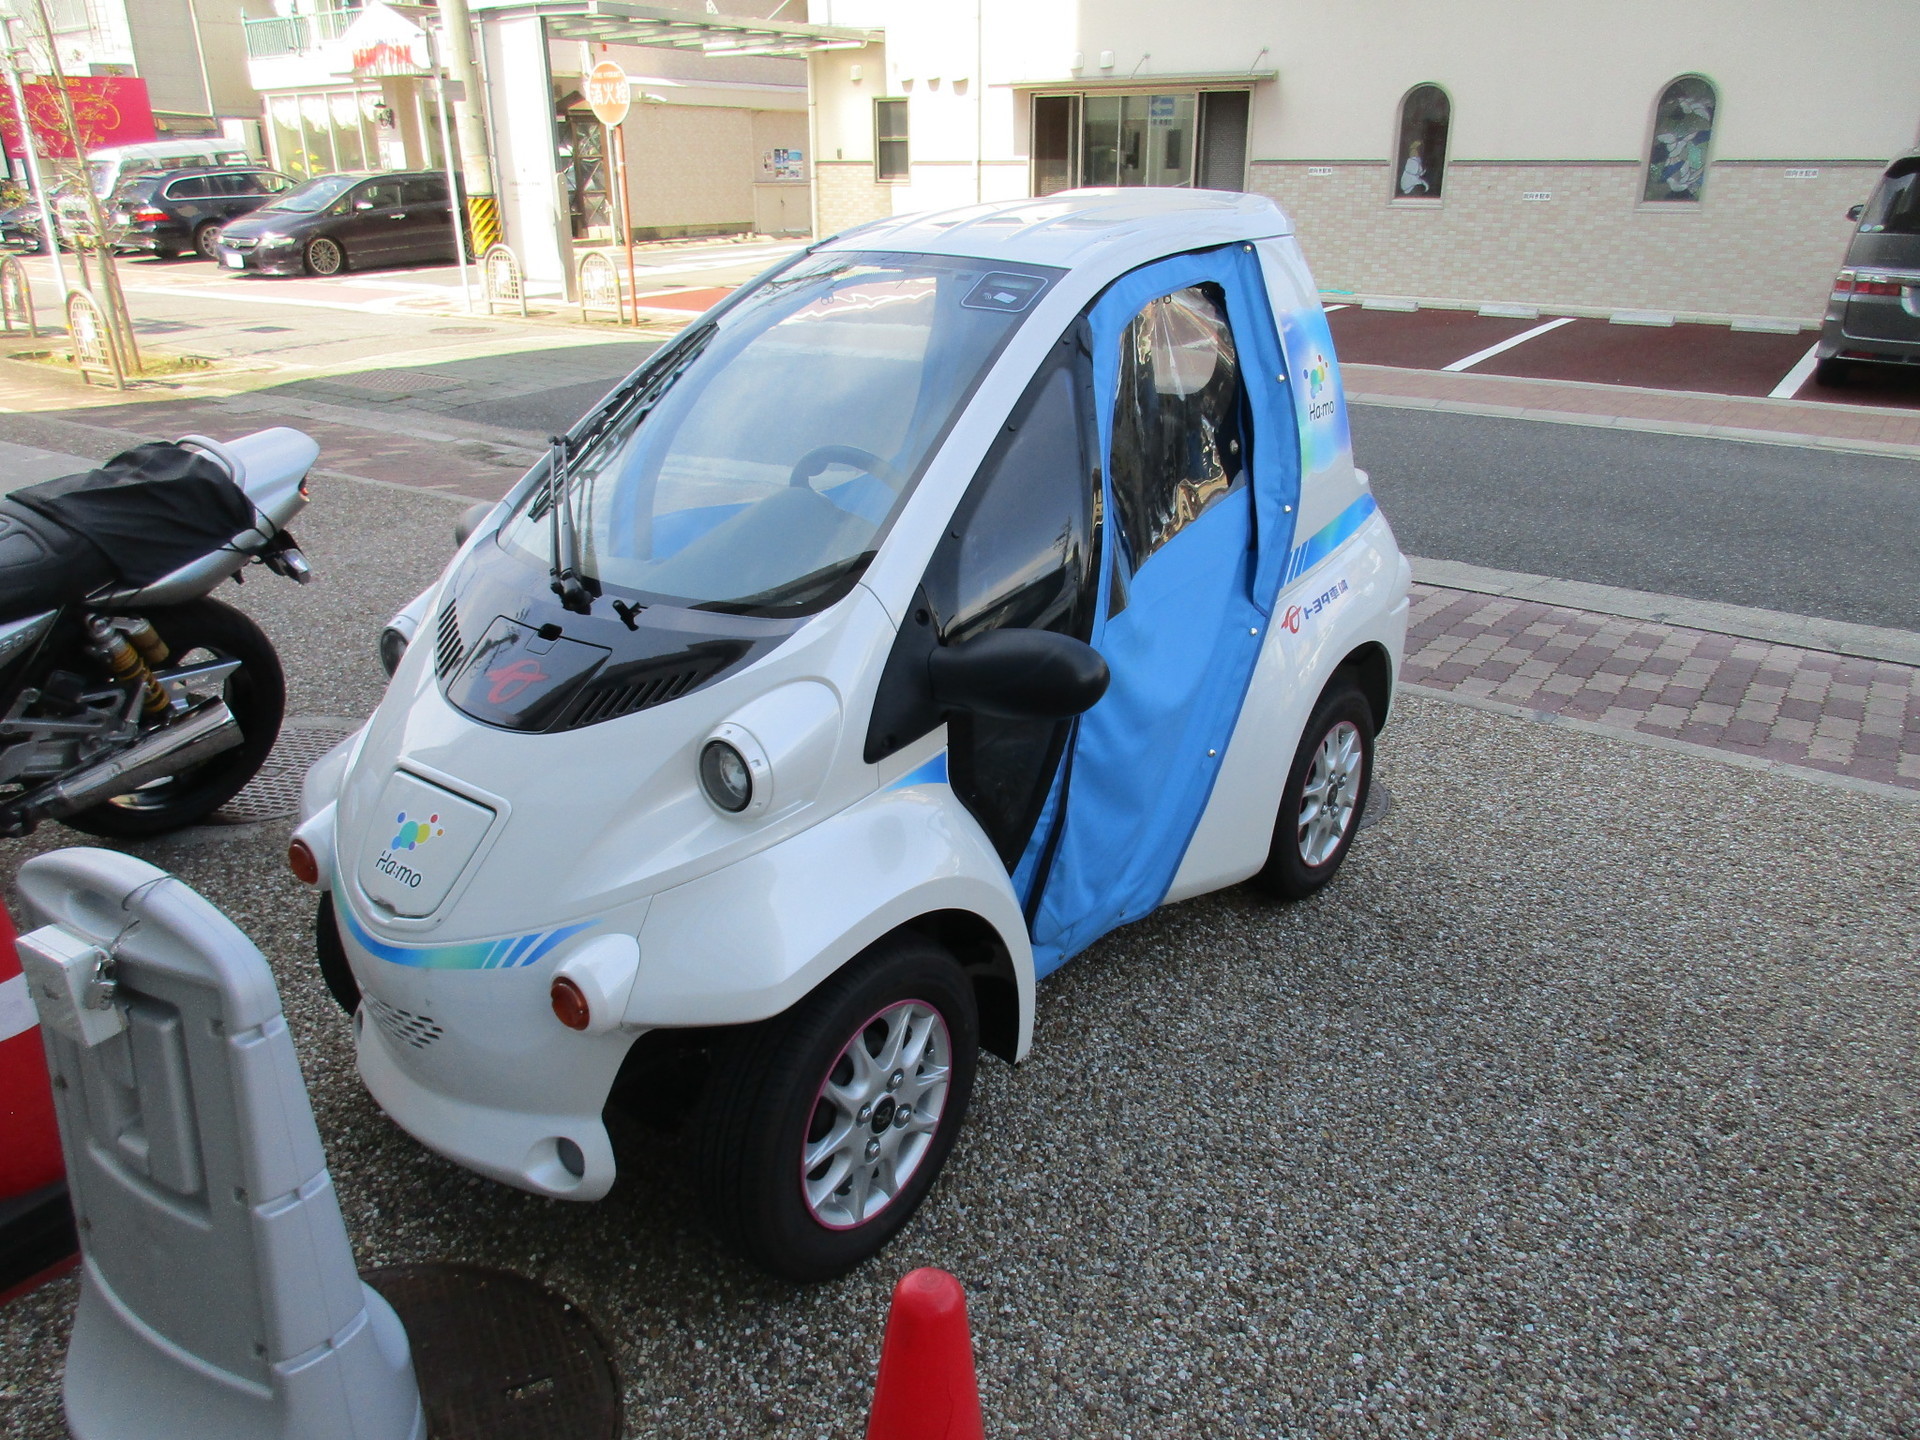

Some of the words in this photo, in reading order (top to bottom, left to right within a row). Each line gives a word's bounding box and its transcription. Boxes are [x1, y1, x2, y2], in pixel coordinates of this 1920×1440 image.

[590, 82, 629, 105] 消火栓
[1309, 401, 1334, 421] Ha:mo
[375, 850, 422, 888] Ha:mo
